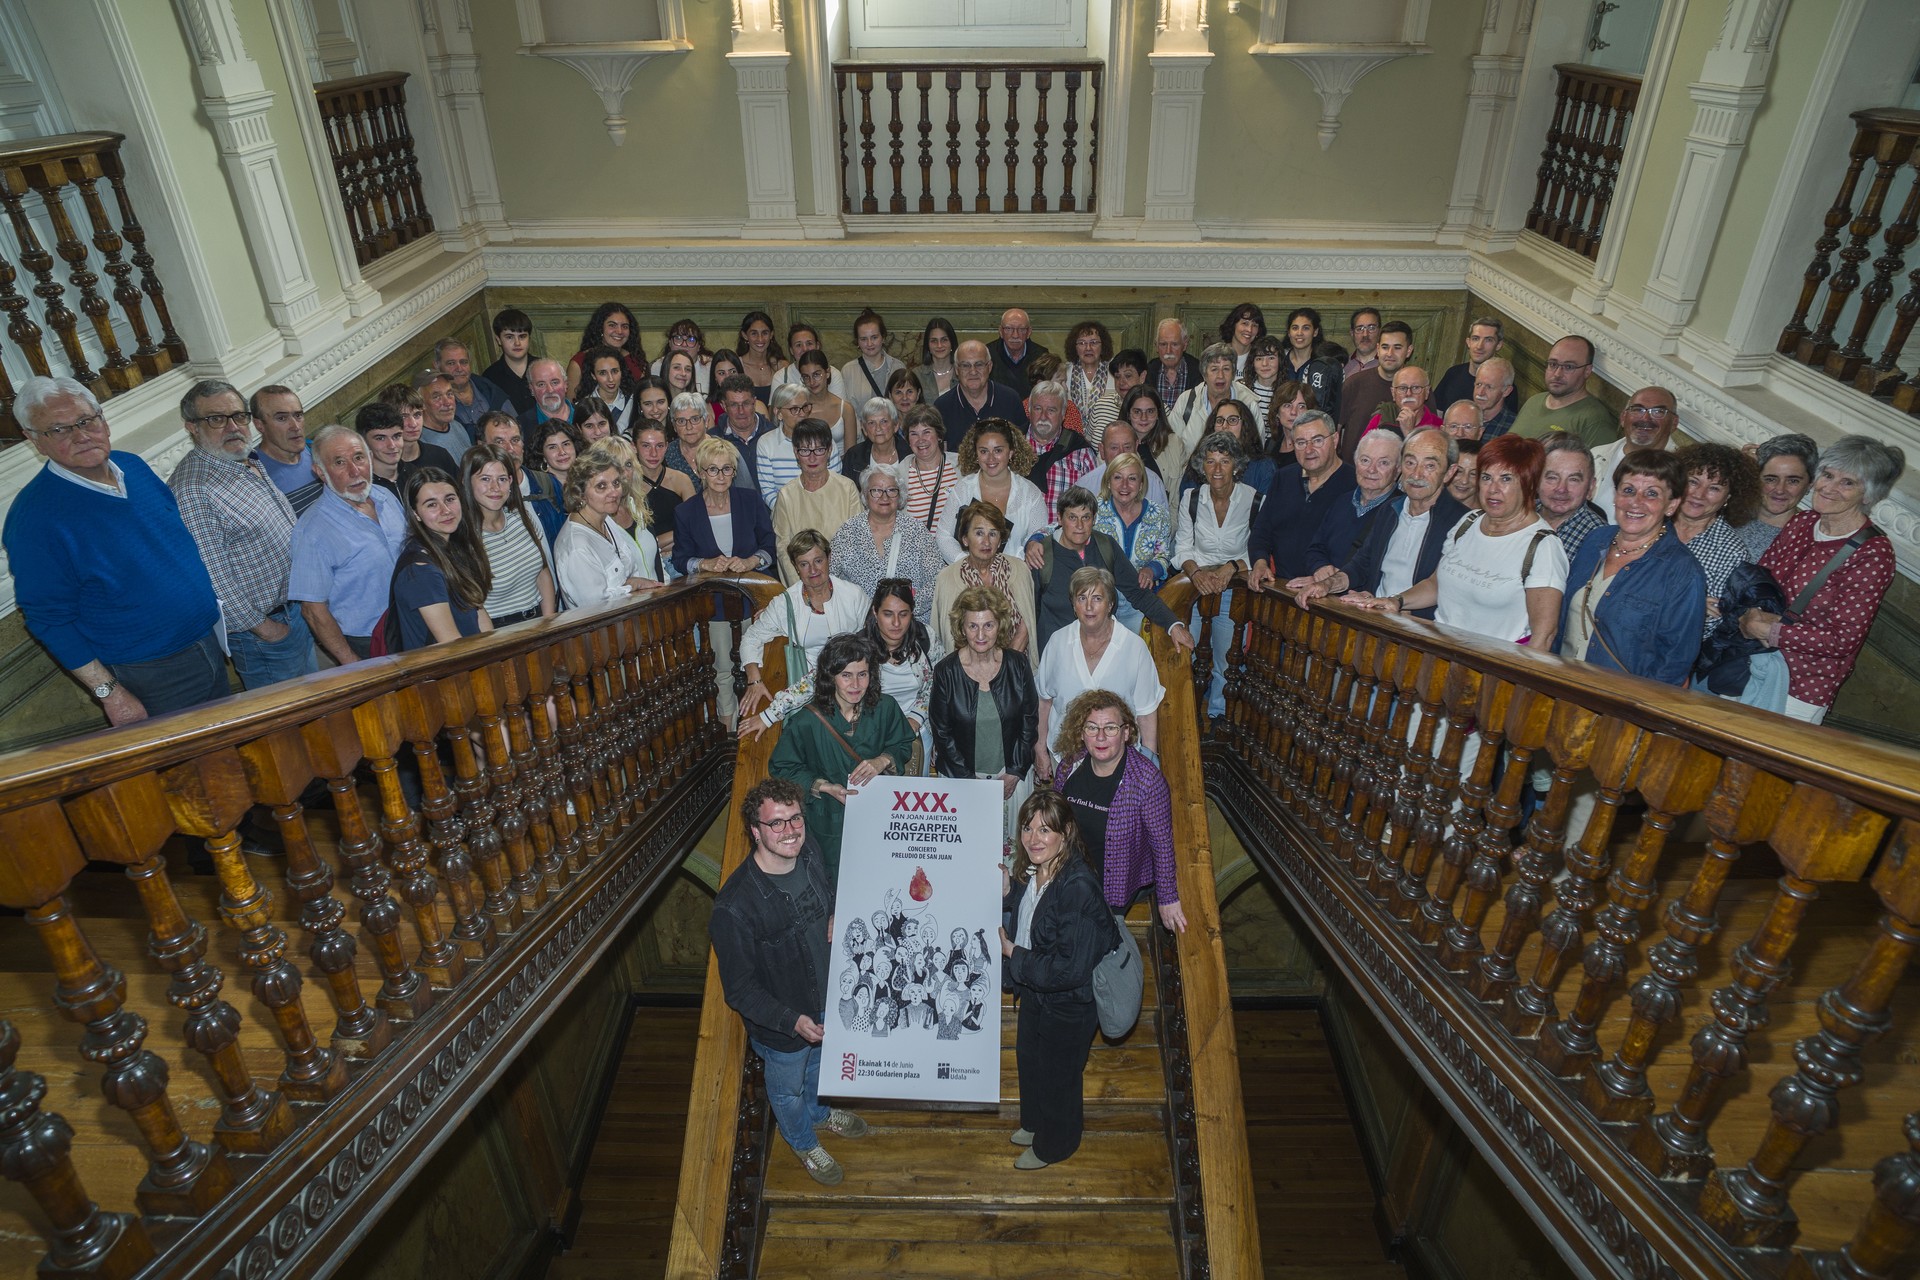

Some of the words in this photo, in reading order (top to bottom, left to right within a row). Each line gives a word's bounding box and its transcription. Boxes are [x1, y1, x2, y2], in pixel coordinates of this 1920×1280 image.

[1470, 578, 1493, 589] MUSE
[892, 791, 957, 813] XXX.
[889, 822, 957, 833] IRAGARPEN
[883, 831, 962, 843] KONTZERTUA
[841, 1053, 856, 1081] 2025
[858, 1059, 882, 1067] Ekainak
[857, 1069, 875, 1077] 22:30
[875, 1069, 903, 1078] Gudarien
[904, 1071, 920, 1079] plaza
